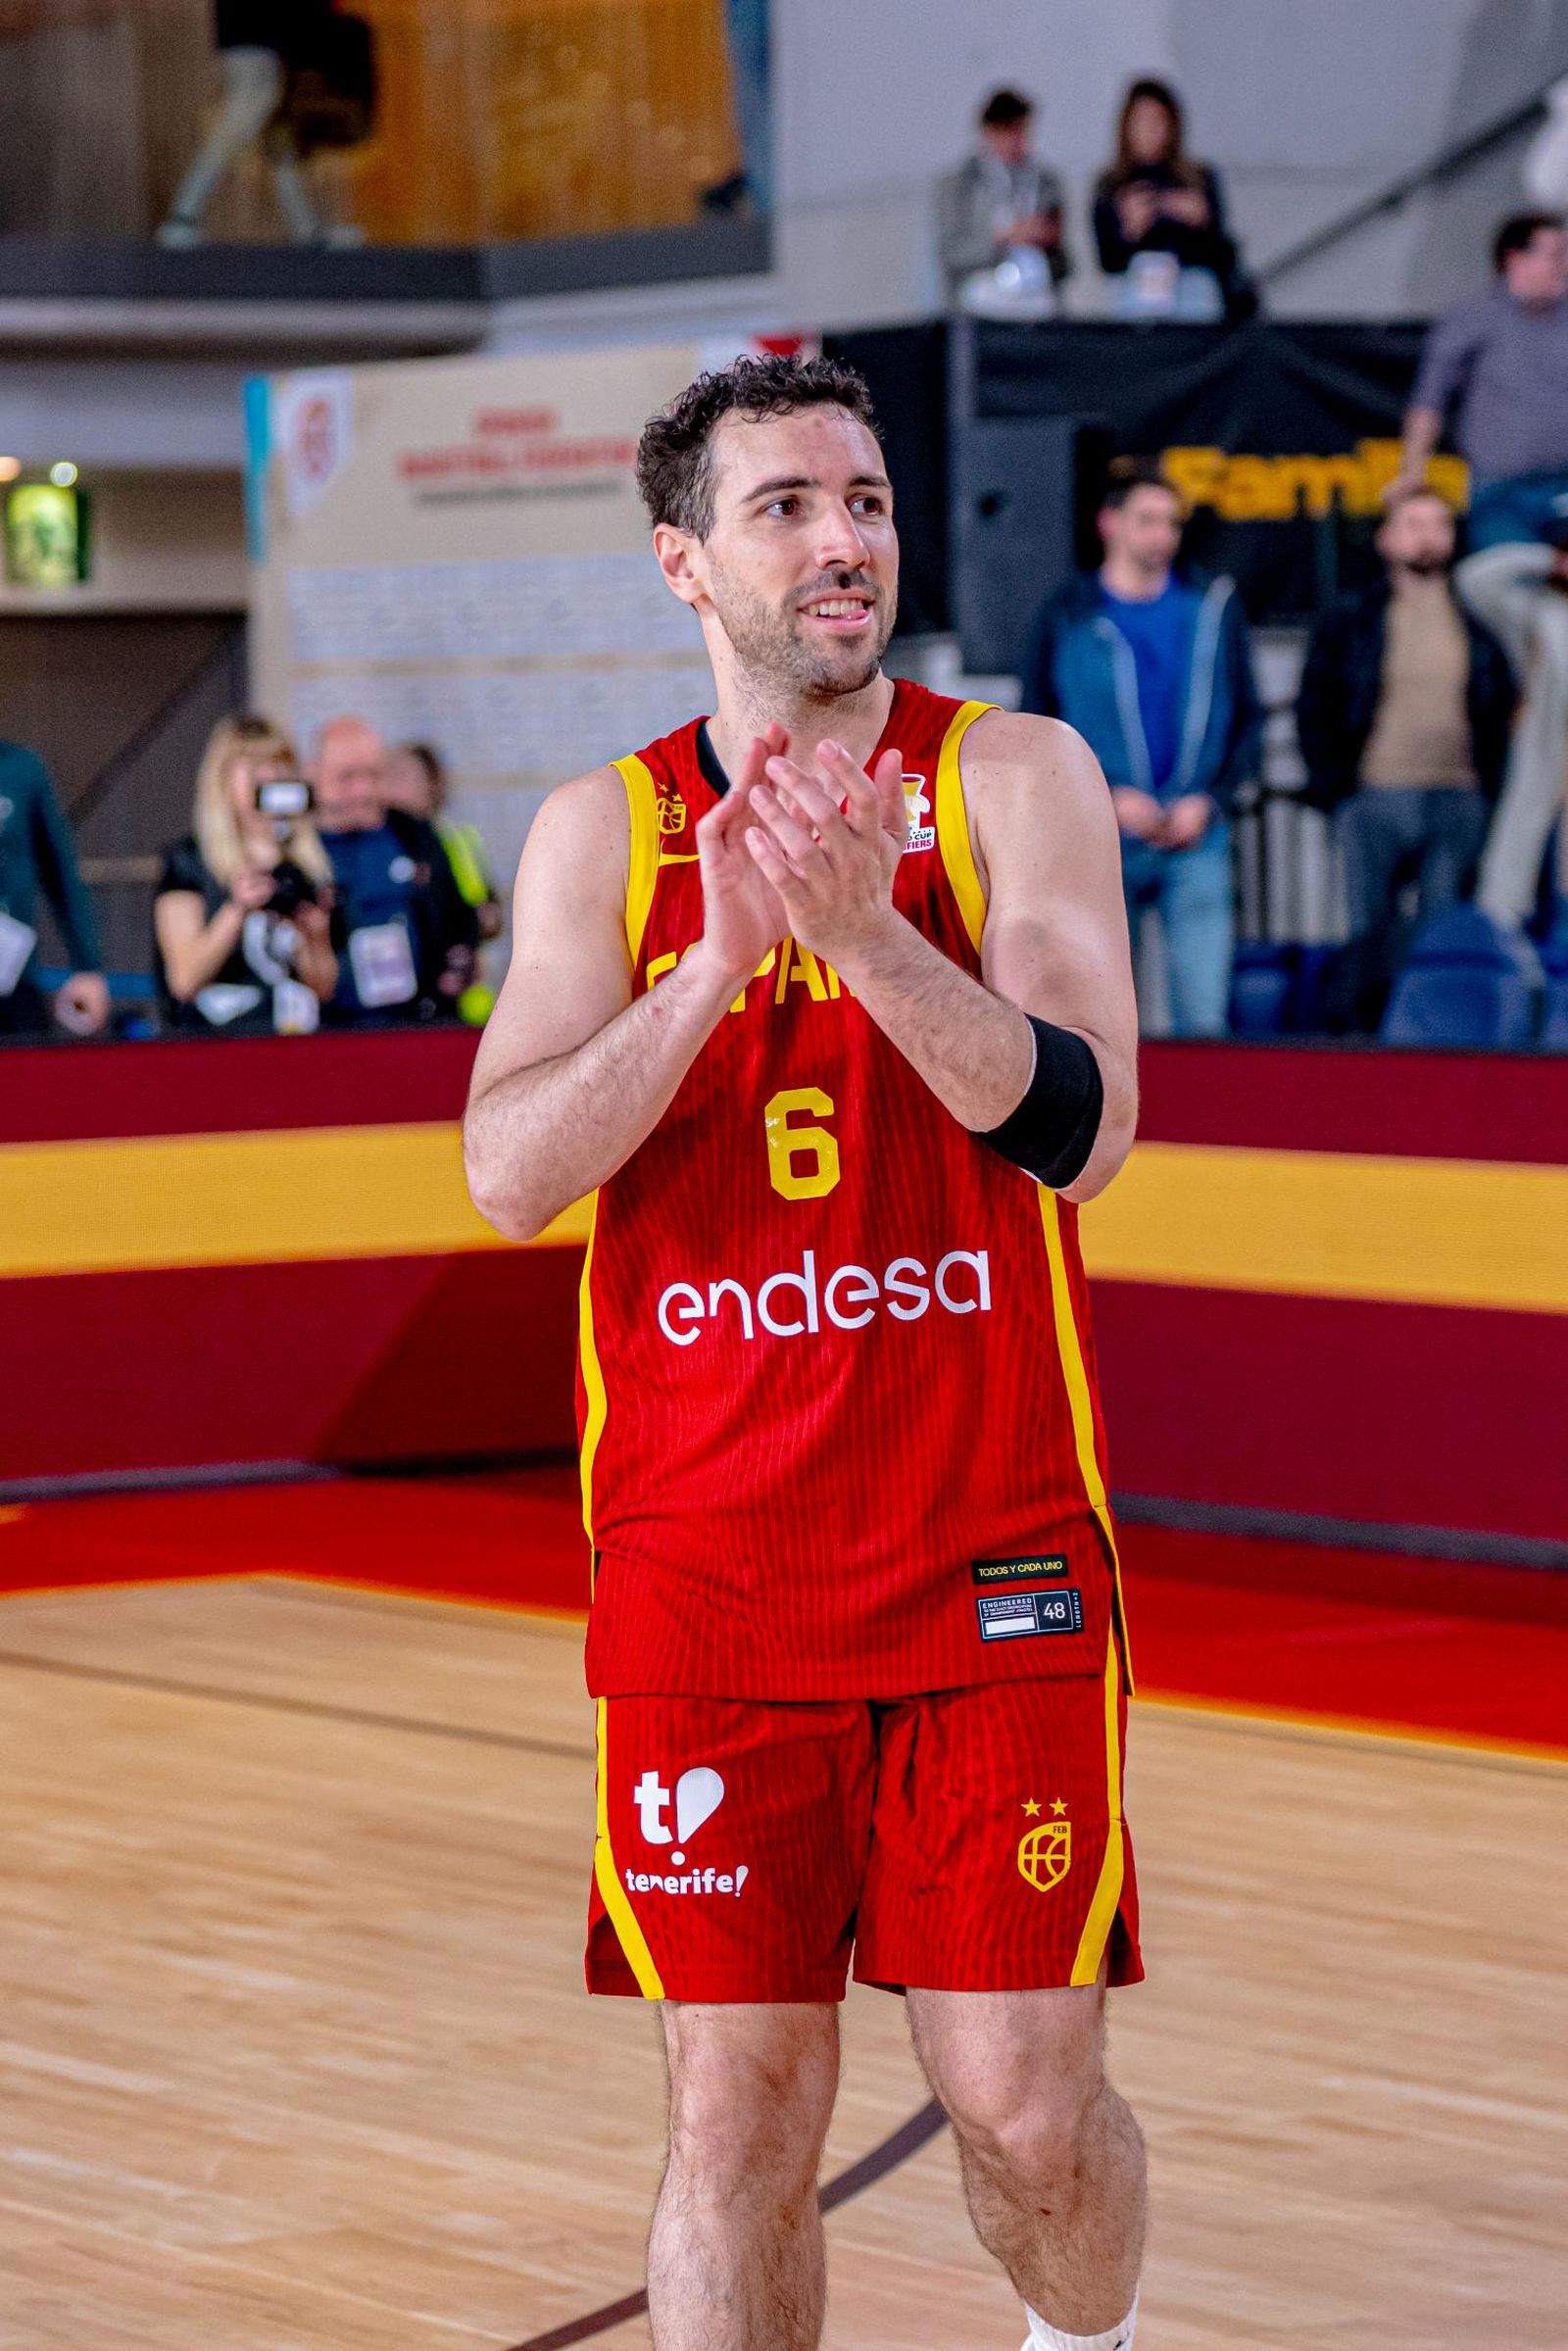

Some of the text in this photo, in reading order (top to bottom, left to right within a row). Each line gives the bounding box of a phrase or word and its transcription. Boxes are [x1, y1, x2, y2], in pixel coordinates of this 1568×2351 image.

[914, 832, 932, 841] CUP
[905, 839, 932, 850] FIERS
[764, 1087, 841, 1201] 6
[658, 1249, 992, 1347] endesa
[978, 1560, 1063, 1577] TODOS Y CADA UNO
[982, 1597, 1032, 1609] ENGINEERED
[1043, 1601, 1066, 1620] 48
[1053, 1825, 1068, 1835] FEB
